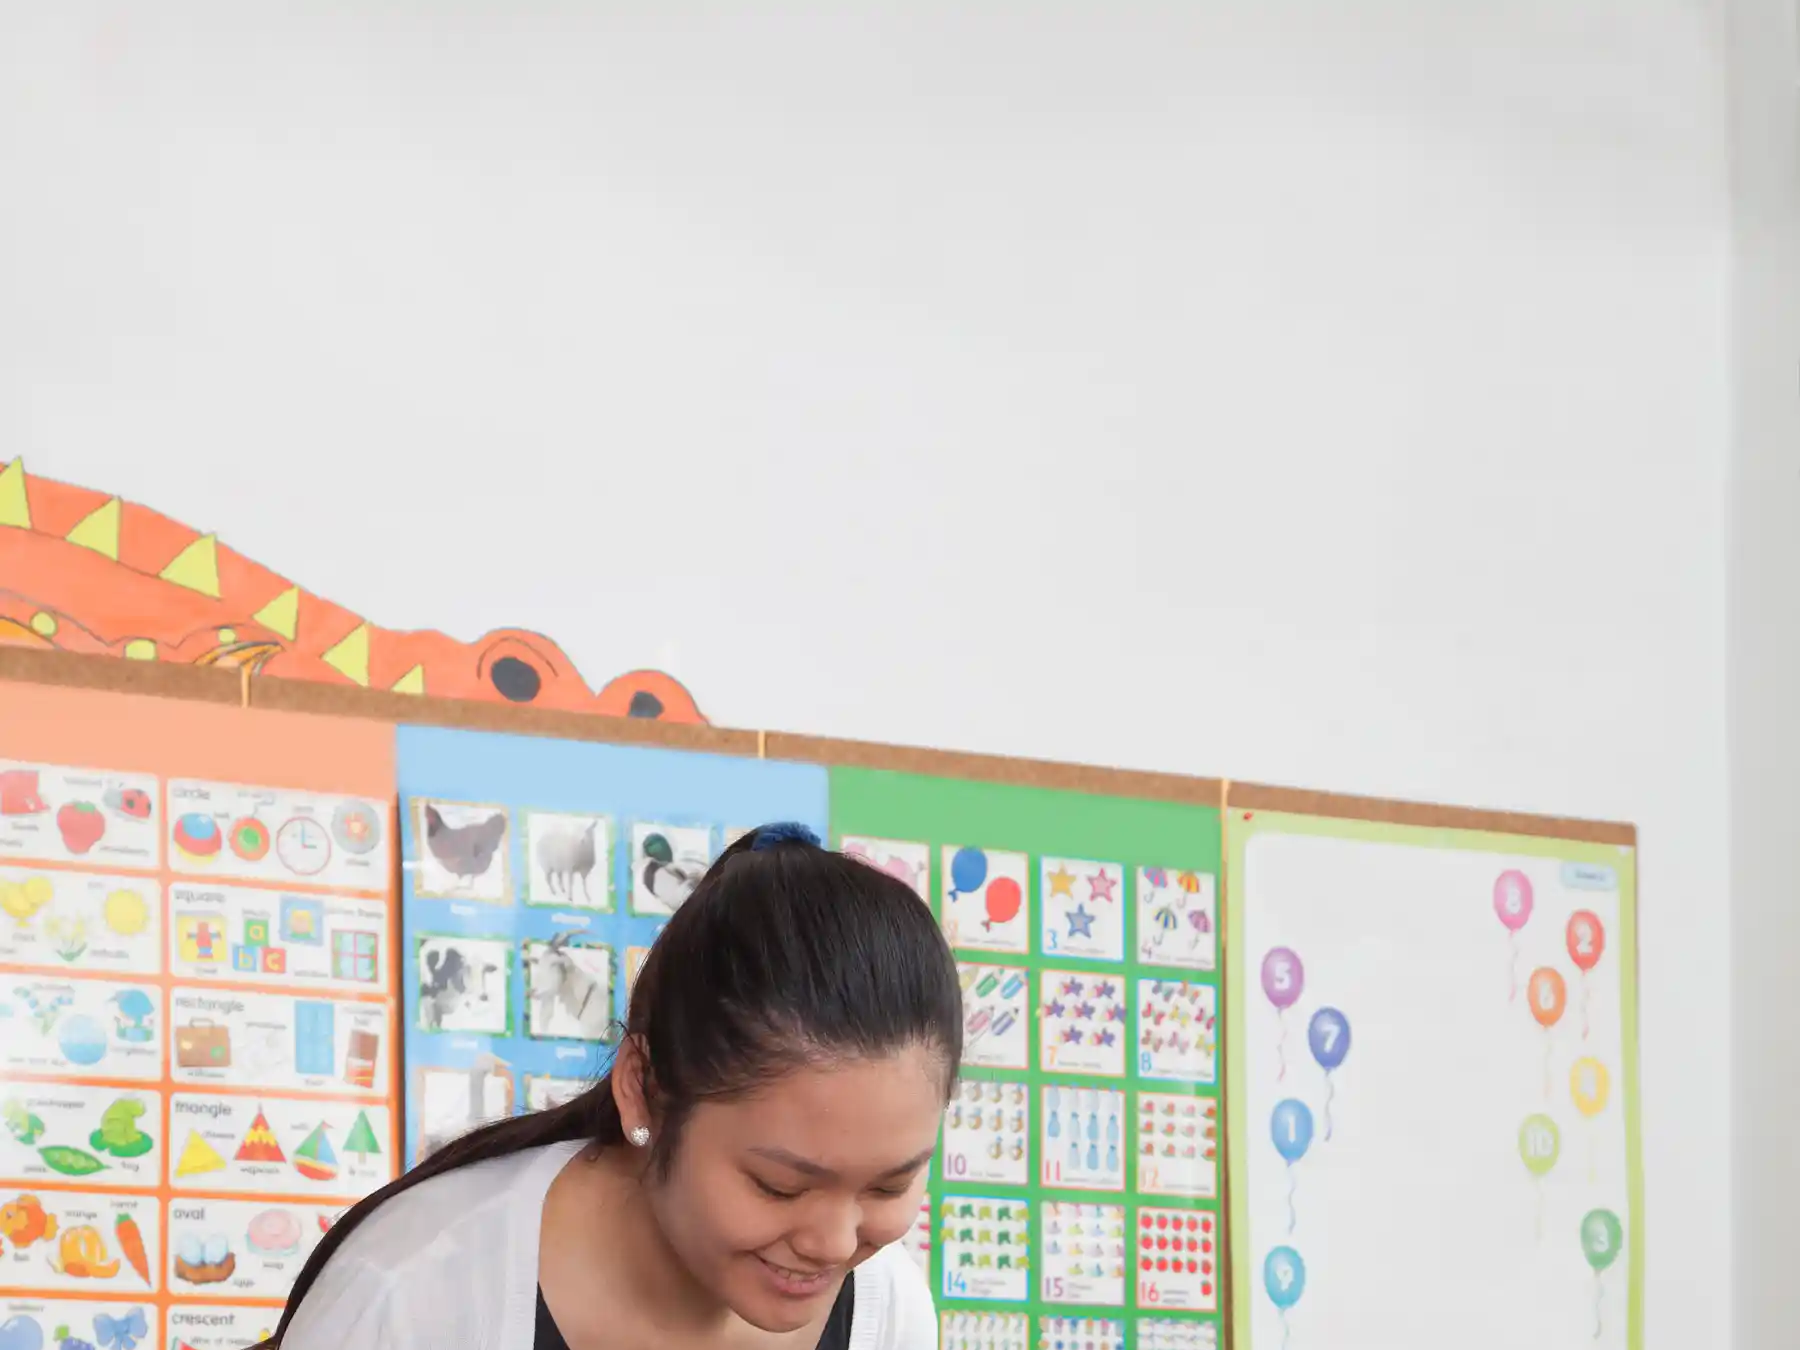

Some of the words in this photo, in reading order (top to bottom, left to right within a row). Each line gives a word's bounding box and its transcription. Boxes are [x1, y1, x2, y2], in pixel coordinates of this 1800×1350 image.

[249, 926, 264, 940] a
[1047, 928, 1058, 950] 3
[1576, 922, 1593, 954] 2
[238, 949, 253, 969] b
[266, 953, 281, 970] c
[1274, 961, 1291, 990] 5
[1322, 1024, 1340, 1053] 7
[1047, 1044, 1058, 1066] 7
[1141, 1051, 1152, 1073] 8
[175, 1100, 233, 1118] triangle
[1286, 1113, 1296, 1144] 1
[946, 1152, 967, 1176] 10
[1045, 1158, 1061, 1181] 11
[173, 1207, 205, 1220] oval
[947, 1270, 967, 1293] 14
[1045, 1276, 1064, 1298] 15
[1140, 1280, 1160, 1302] 16
[172, 1312, 236, 1326] crescent
